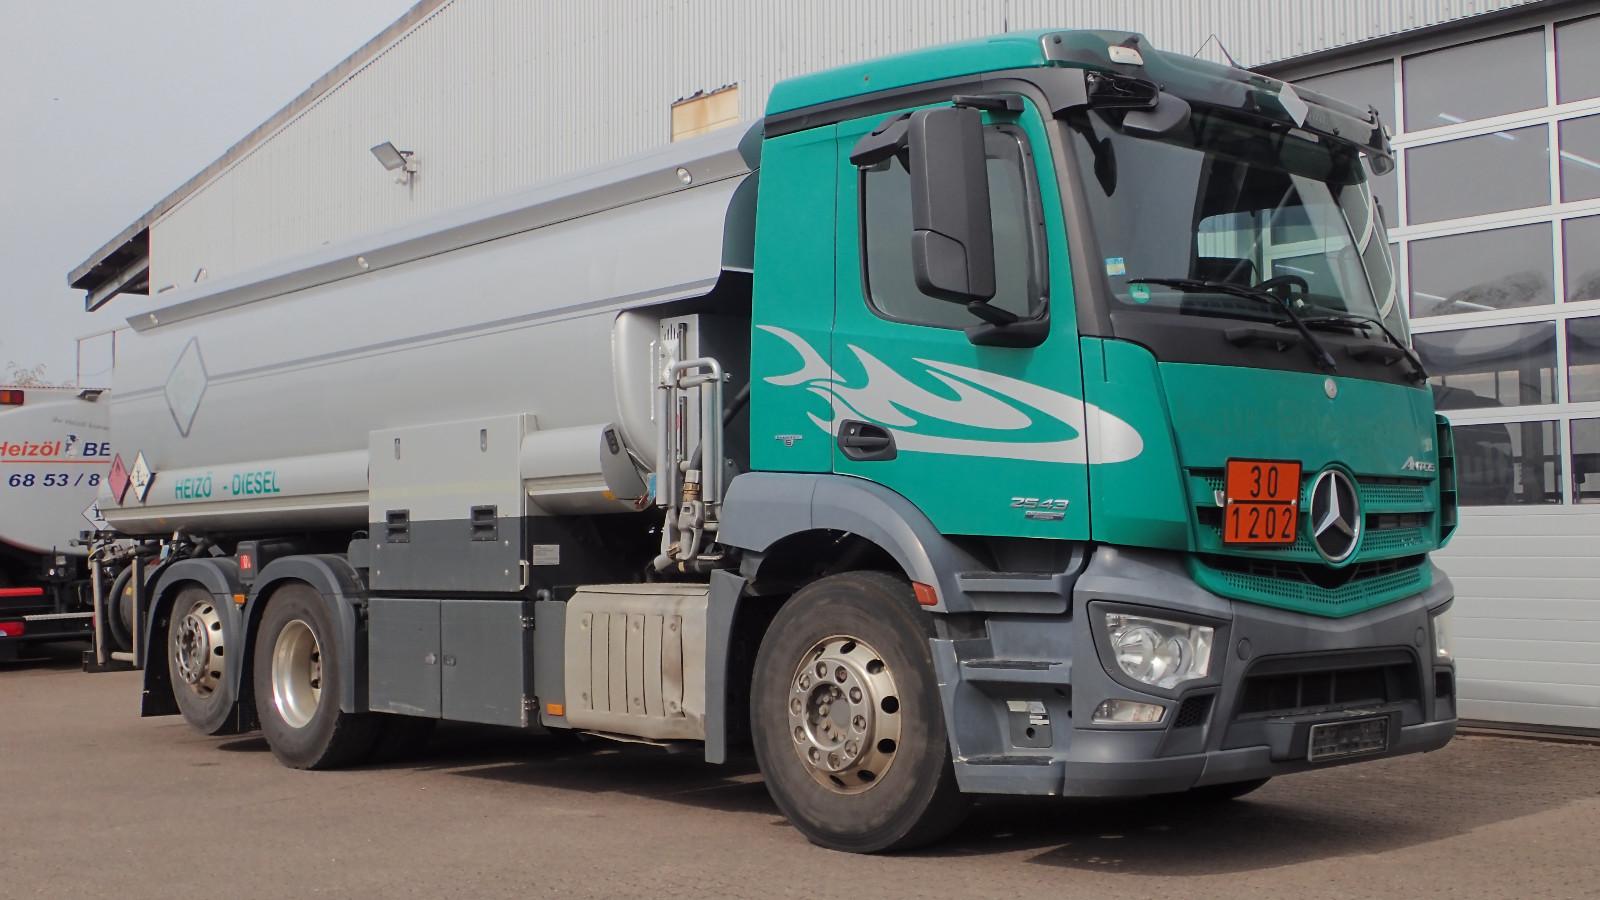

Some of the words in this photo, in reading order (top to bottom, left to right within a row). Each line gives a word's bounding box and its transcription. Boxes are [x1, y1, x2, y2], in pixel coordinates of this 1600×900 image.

[82, 442, 111, 457] BE
[8, 473, 36, 487] 68
[43, 473, 69, 487] 53
[73, 473, 84, 487] /
[231, 471, 281, 496] DIESEL
[1250, 465, 1280, 499] 30
[1010, 496, 1069, 510] 2543
[1232, 506, 1293, 540] 1202
